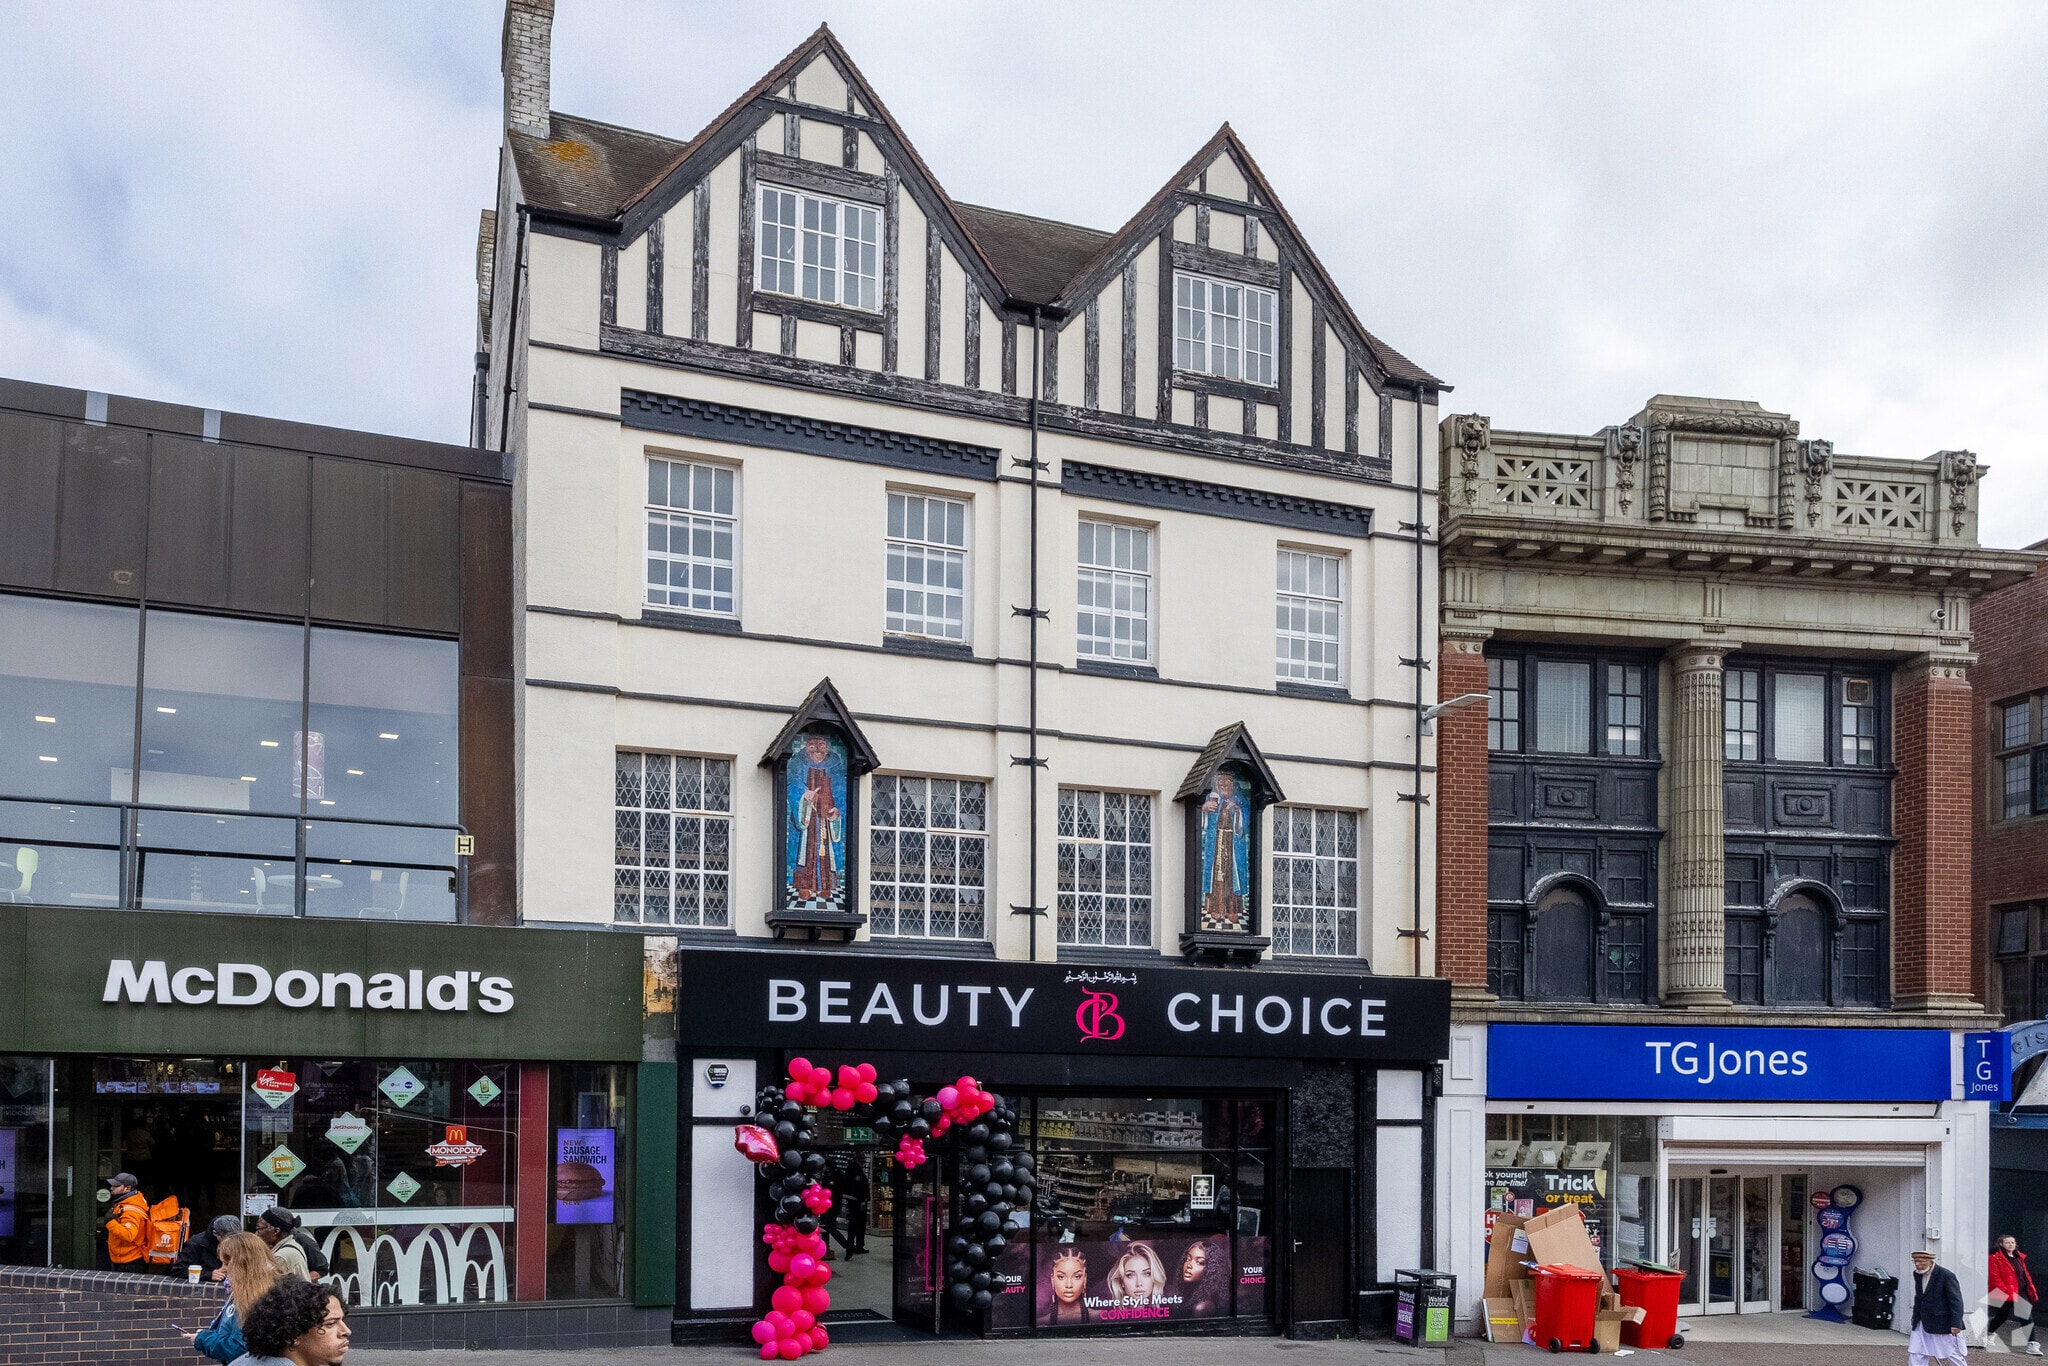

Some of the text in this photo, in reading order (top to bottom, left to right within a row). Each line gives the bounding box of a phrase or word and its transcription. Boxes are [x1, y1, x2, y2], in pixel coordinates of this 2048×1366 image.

[102, 959, 515, 1013] McDonald's
[768, 979, 1035, 1027] BEAUTY
[1167, 992, 1386, 1037] CHOICE
[1976, 1039, 1991, 1058] T
[1976, 1061, 1992, 1081] G
[1969, 1082, 1999, 1094] Jones
[431, 1146, 481, 1155] MONOPOLY
[563, 1146, 601, 1155] SAUSAGE
[563, 1155, 607, 1164] SANDWICH
[1495, 1171, 1528, 1179] yourself
[1496, 1179, 1528, 1187] me-time!
[1544, 1174, 1595, 1191] Trick
[1545, 1193, 1594, 1204] or treat
[1242, 1266, 1263, 1274] YOUR
[1005, 1275, 1022, 1283] OUR
[1239, 1276, 1266, 1284] CHOICE
[1004, 1285, 1026, 1293] AUTY
[1083, 1294, 1183, 1308] Where Style Meets
[1100, 1307, 1170, 1320] CONFIDENCE
